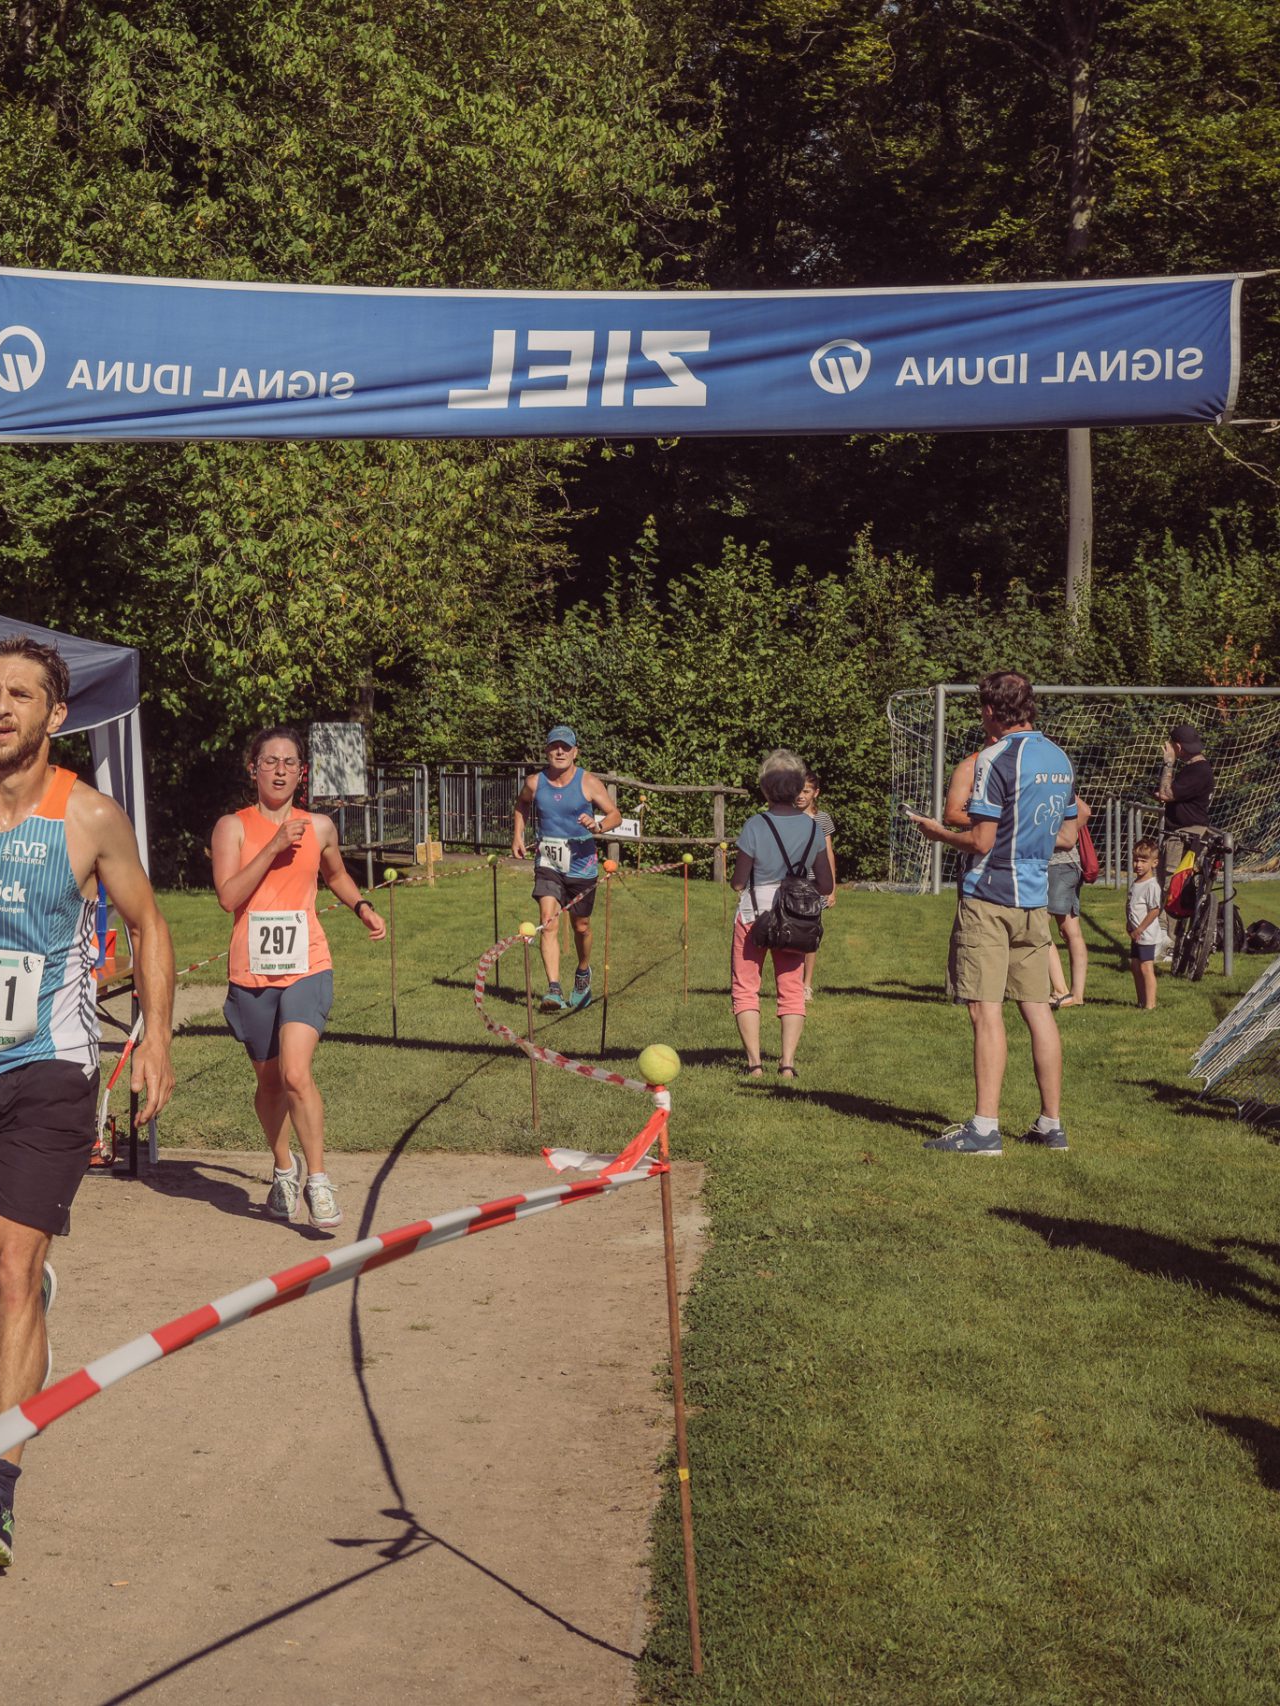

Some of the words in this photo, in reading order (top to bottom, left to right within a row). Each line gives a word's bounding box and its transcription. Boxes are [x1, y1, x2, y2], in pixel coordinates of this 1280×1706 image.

[1034, 773, 1048, 785] SV
[12, 840, 48, 858] TVB
[260, 926, 297, 955] 297
